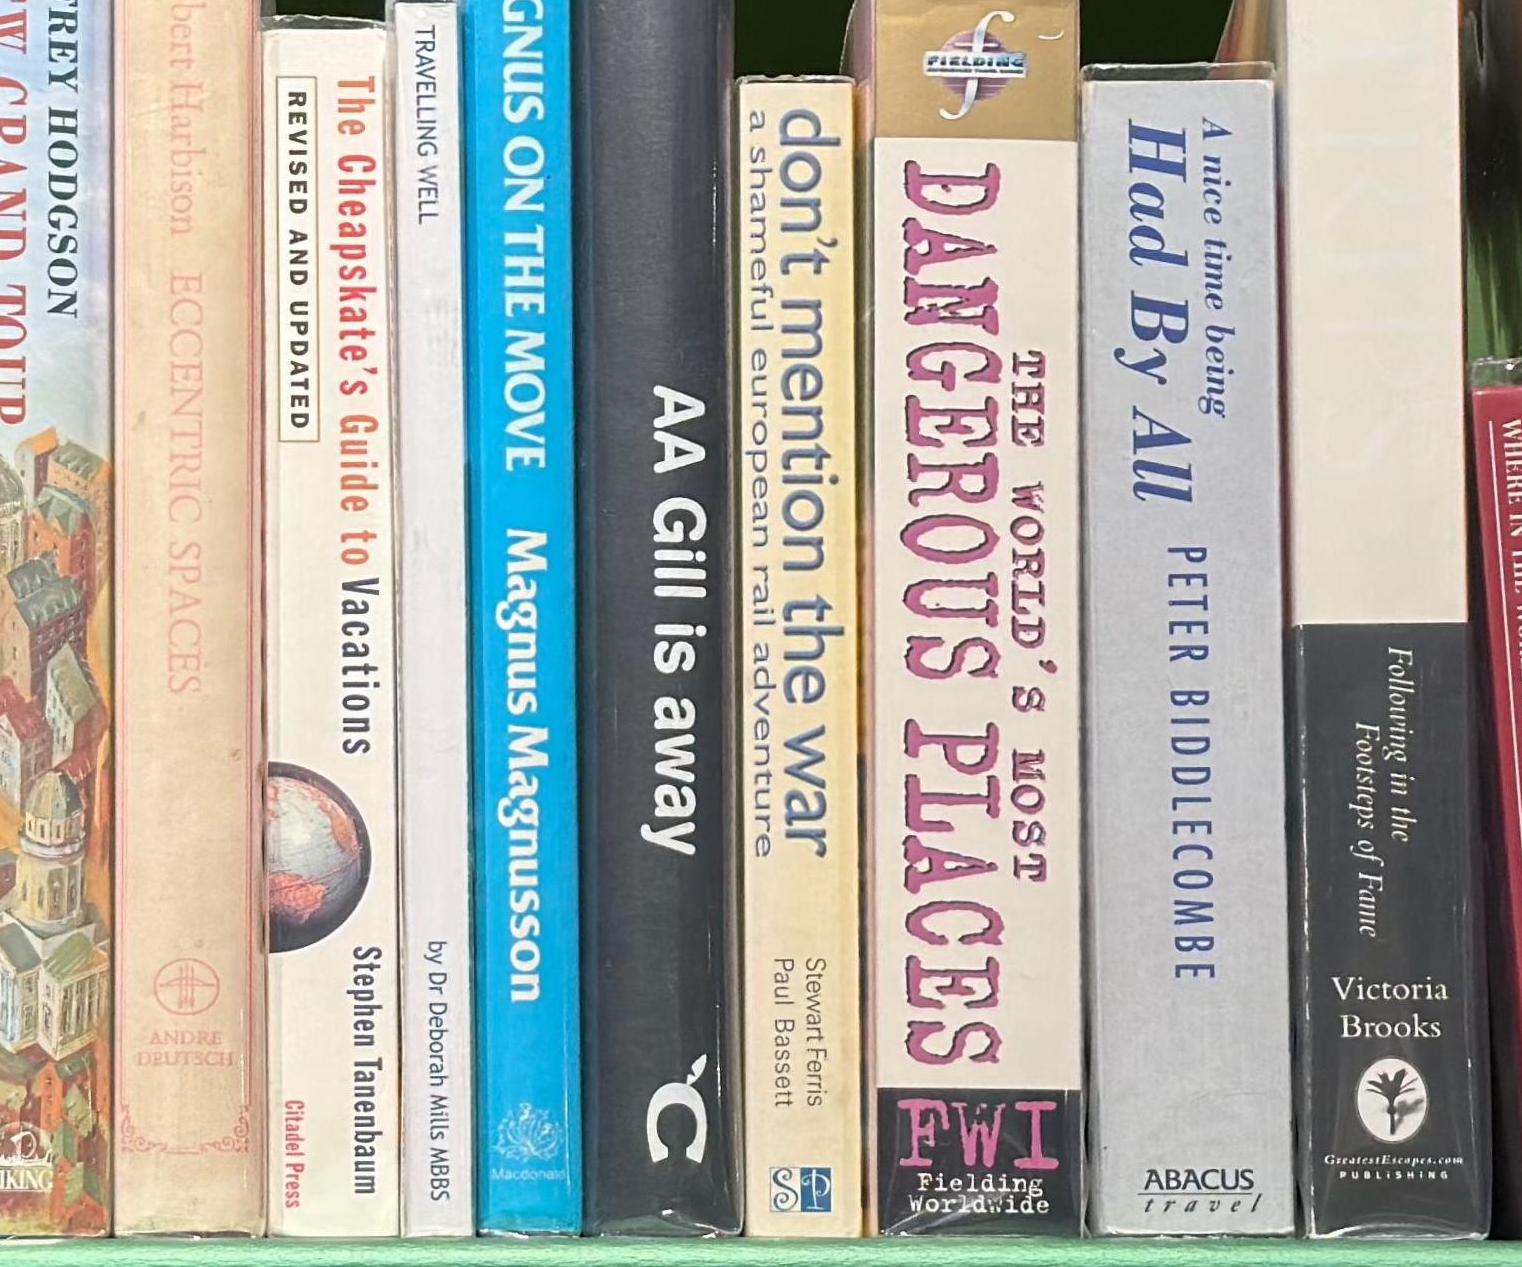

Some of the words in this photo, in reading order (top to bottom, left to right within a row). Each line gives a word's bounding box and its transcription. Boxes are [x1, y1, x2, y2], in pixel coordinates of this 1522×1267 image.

[335, 75, 376, 136] The
[413, 23, 438, 158] TRAVELLING
[748, 110, 766, 133] a
[1201, 116, 1234, 142] A
[168, 81, 205, 237] Harbison
[287, 91, 309, 214] REVISED
[417, 164, 441, 226] WELL
[503, 135, 546, 214] ON
[778, 107, 842, 276] don't
[1127, 117, 1190, 268] Had
[1203, 155, 1234, 225] nice
[46, 108, 79, 320] HODGSON
[288, 229, 310, 287] AND
[748, 146, 775, 332] shameful
[329, 154, 379, 397] Cheapskate's
[503, 227, 546, 319] THE
[1203, 238, 1234, 311] time
[289, 301, 310, 430] UPDATED
[1113, 289, 1190, 386] By
[1198, 326, 1236, 419] being
[167, 272, 205, 524] ECCENTRIC
[503, 329, 547, 473] MOVE
[651, 384, 708, 474] AA
[779, 298, 839, 573] mention
[900, 159, 1002, 679] DANGEROUS
[339, 414, 380, 513] Guide
[744, 347, 770, 549] european
[1132, 404, 1194, 503] All
[339, 529, 378, 566] to
[651, 496, 708, 600] Gill
[166, 541, 203, 695] SPACES
[495, 527, 549, 717] Magnus
[750, 565, 777, 628] rail
[1167, 545, 1210, 664] PETER
[341, 577, 381, 756] Vacations
[652, 622, 708, 676] is
[781, 593, 846, 706] the
[1382, 646, 1416, 762] Following
[639, 695, 697, 856] away
[751, 642, 778, 859] adventure
[782, 724, 829, 860] war
[1348, 721, 1381, 831] Footsteps
[1389, 771, 1416, 796] in
[496, 723, 550, 1005] Magnusson
[1169, 689, 1216, 980] BIDDLECOMBE
[1349, 839, 1385, 868] of
[1389, 804, 1419, 843] the
[902, 717, 1006, 1066] PLACES
[1356, 871, 1384, 939] Fame
[346, 945, 383, 1048] Stephen
[422, 939, 449, 966] by
[427, 971, 449, 995] Dr
[773, 957, 795, 1007] Paul
[1330, 975, 1450, 1001] Victoria
[428, 1002, 450, 1088] Deborah
[804, 957, 828, 1045] Stewart
[1339, 1012, 1443, 1039] Brooks
[773, 1018, 795, 1109] Bassett
[805, 1048, 828, 1107] Ferris
[284, 1099, 305, 1158] Citadel
[352, 1057, 383, 1196] Tanenbaum
[428, 1093, 451, 1142] Mills
[896, 1097, 1060, 1170] FWI
[1323, 1154, 1464, 1167] GreatestEscapes.com
[284, 1161, 306, 1210] Press
[429, 1147, 451, 1203] MBBS
[490, 1166, 566, 1182] Macdonald
[908, 1194, 1051, 1214] Worldwide
[916, 1172, 1044, 1197] Fielding
[1144, 1169, 1255, 1192] ABACUS
[1144, 1193, 1263, 1215] travel
